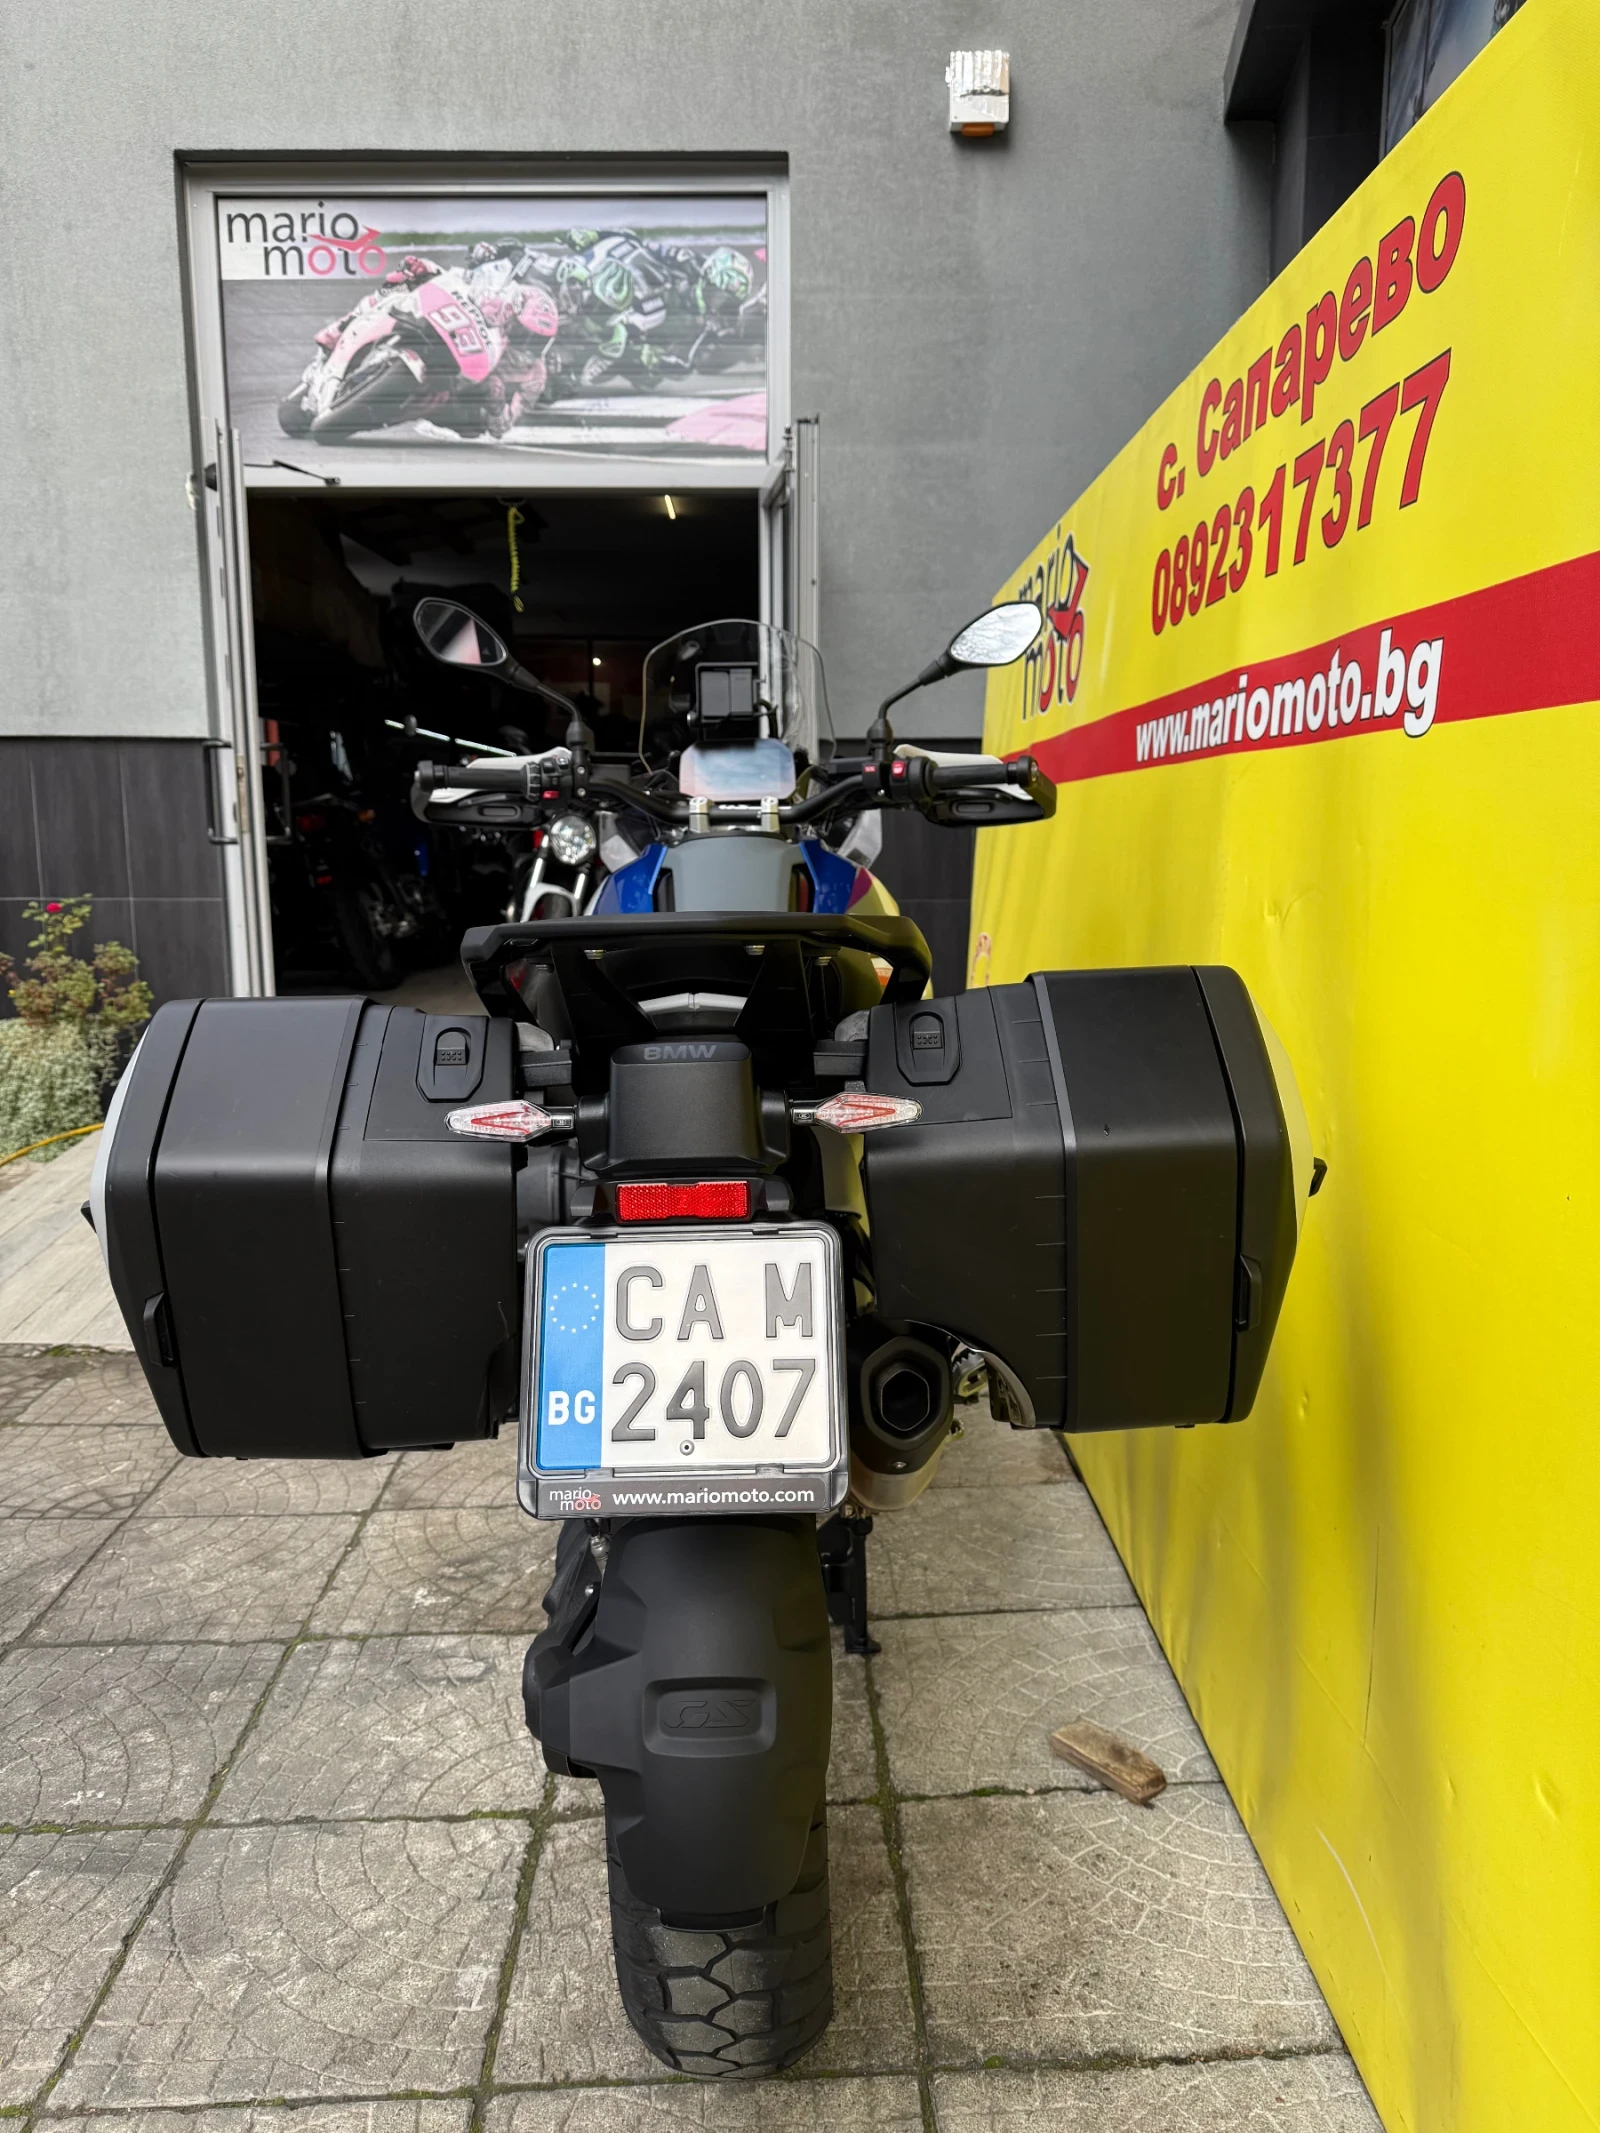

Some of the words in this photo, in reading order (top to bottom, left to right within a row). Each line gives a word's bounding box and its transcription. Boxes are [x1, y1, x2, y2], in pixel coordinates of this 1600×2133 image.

[226, 201, 359, 243] mario
[264, 245, 387, 276] moto
[1157, 443, 1186, 511] с.
[1197, 171, 1467, 477] Сапарево
[1151, 347, 1452, 636] 0892317377
[1023, 611, 1084, 720] moto
[1136, 627, 1444, 738] www.mariomoto.bg
[643, 1044, 717, 1061] BMW
[548, 1390, 596, 1426] BG
[611, 1358, 816, 1442] 2407
[549, 1486, 592, 1501] mario
[560, 1499, 602, 1511] moto
[612, 1487, 815, 1506] www.mariomoto.com
